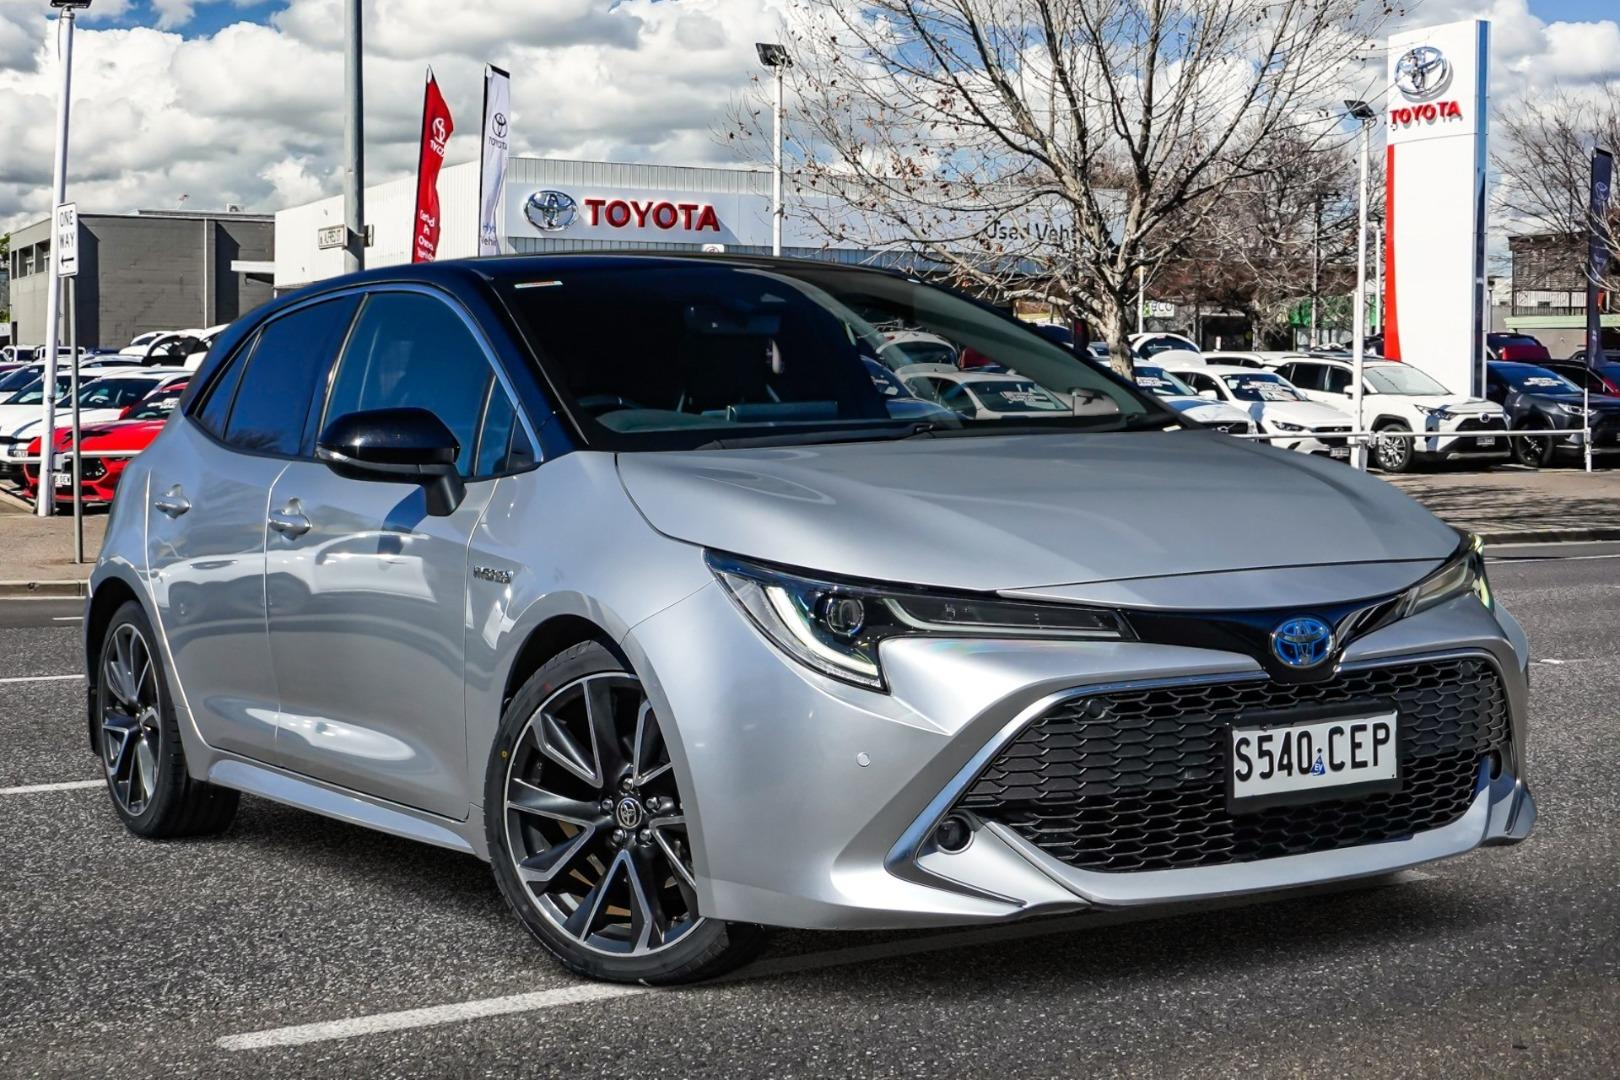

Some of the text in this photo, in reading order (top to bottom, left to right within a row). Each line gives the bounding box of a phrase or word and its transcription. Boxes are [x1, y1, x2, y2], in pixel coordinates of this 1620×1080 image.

[1389, 101, 1462, 124] TOYOTA
[59, 209, 74, 228] ONE
[584, 198, 720, 232] TOYOTA
[59, 232, 75, 249] WAY
[1234, 722, 1390, 782] S540 CEP
